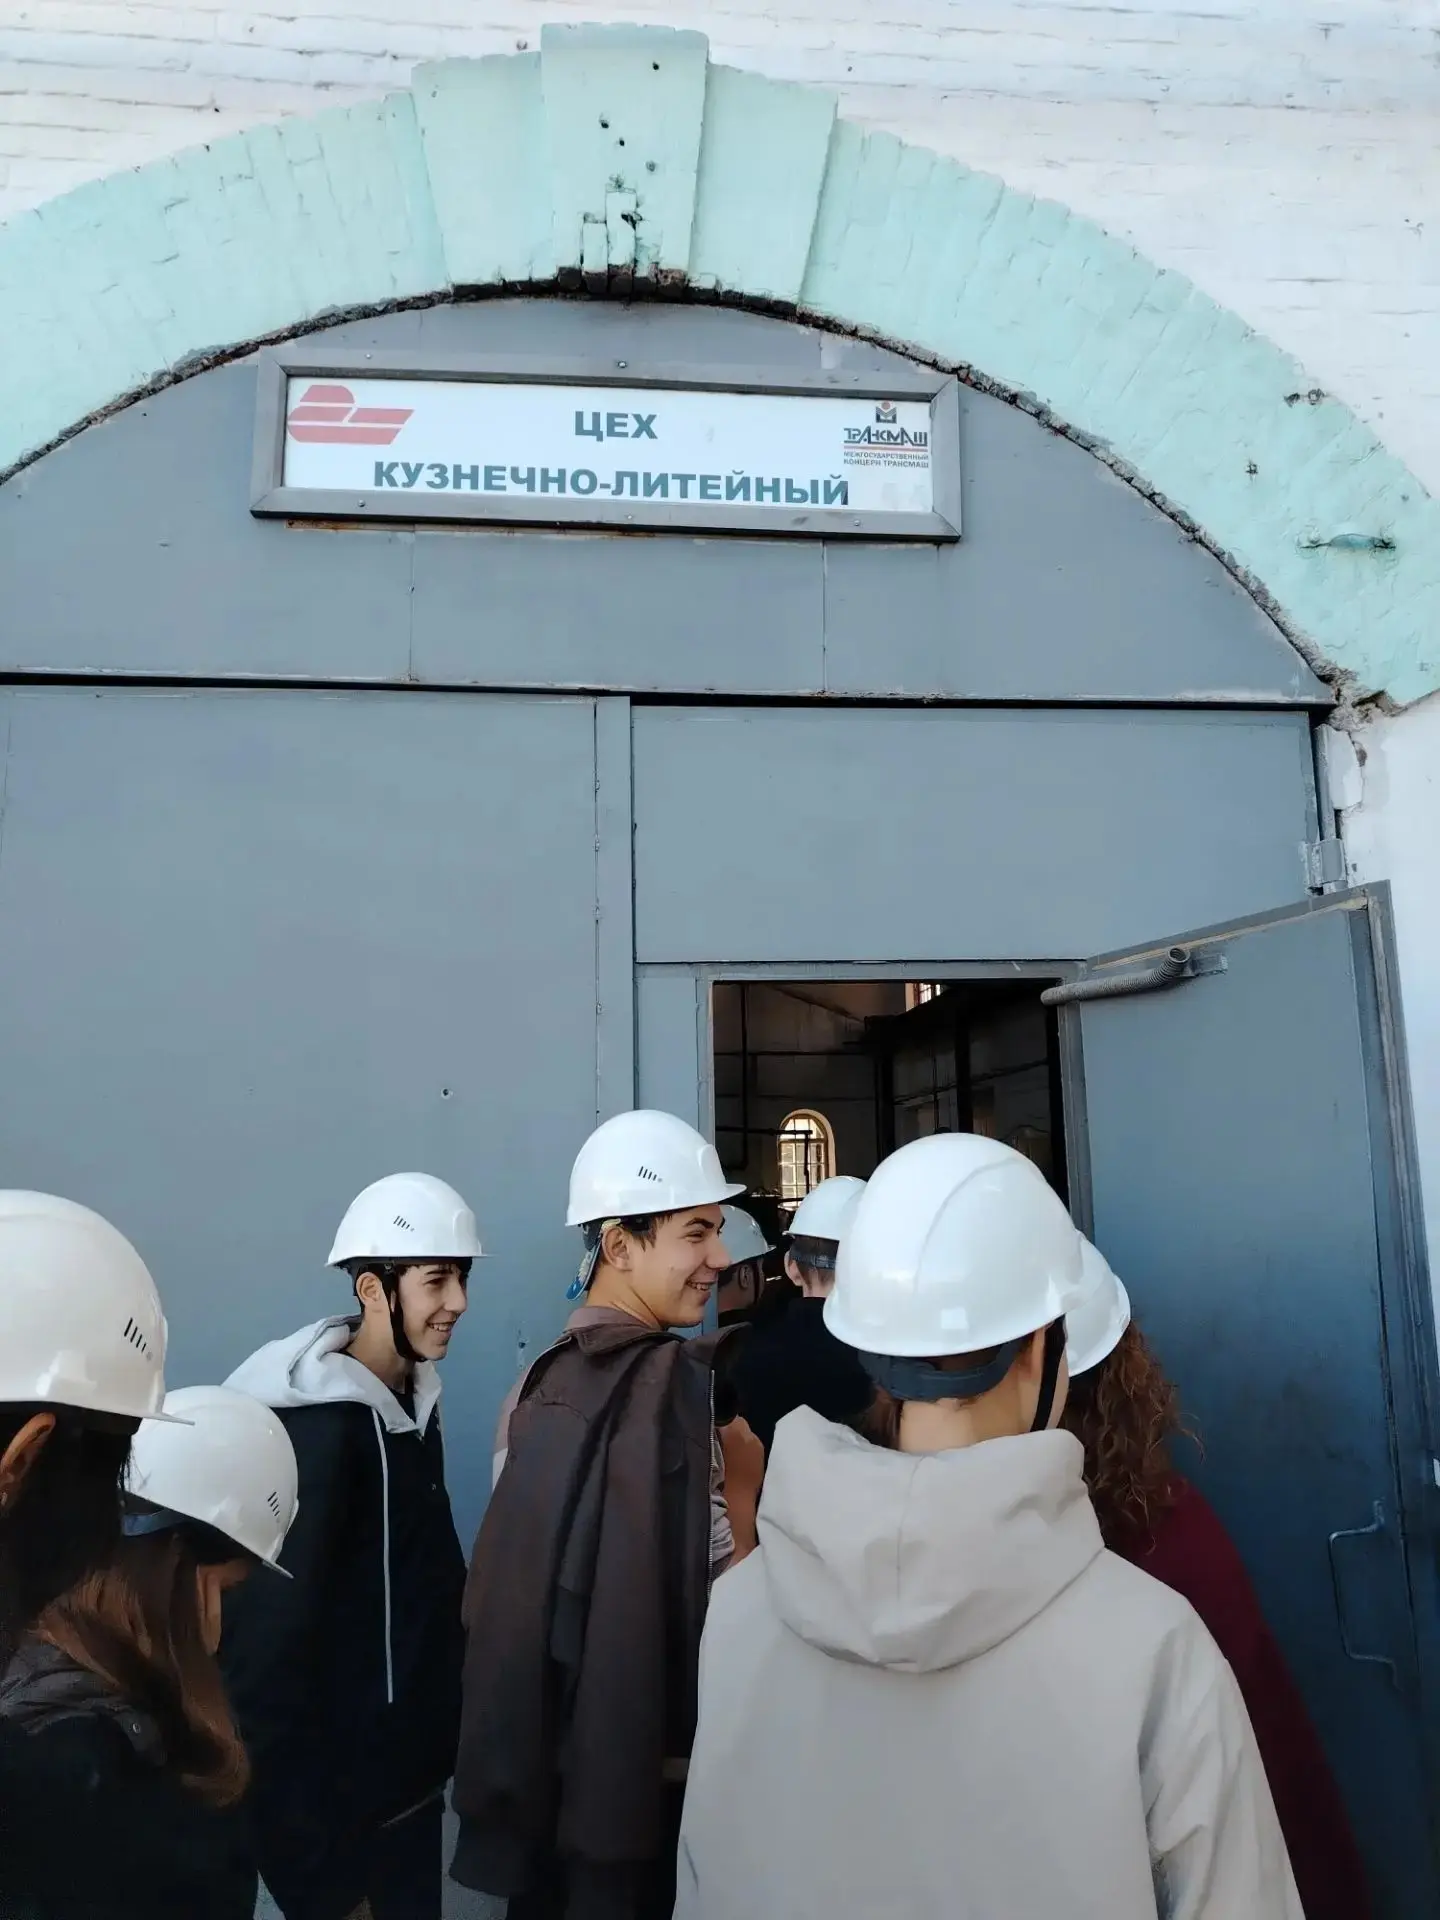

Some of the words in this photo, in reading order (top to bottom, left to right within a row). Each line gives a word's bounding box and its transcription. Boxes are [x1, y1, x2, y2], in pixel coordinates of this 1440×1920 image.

[574, 410, 658, 442] ЦЕХ
[843, 458, 881, 467] КОНЦЕРН
[883, 460, 929, 469] ТРАНСМАШ
[373, 461, 849, 506] КУЗНЕЧНО-ЛИТЕЙНЫЙ
